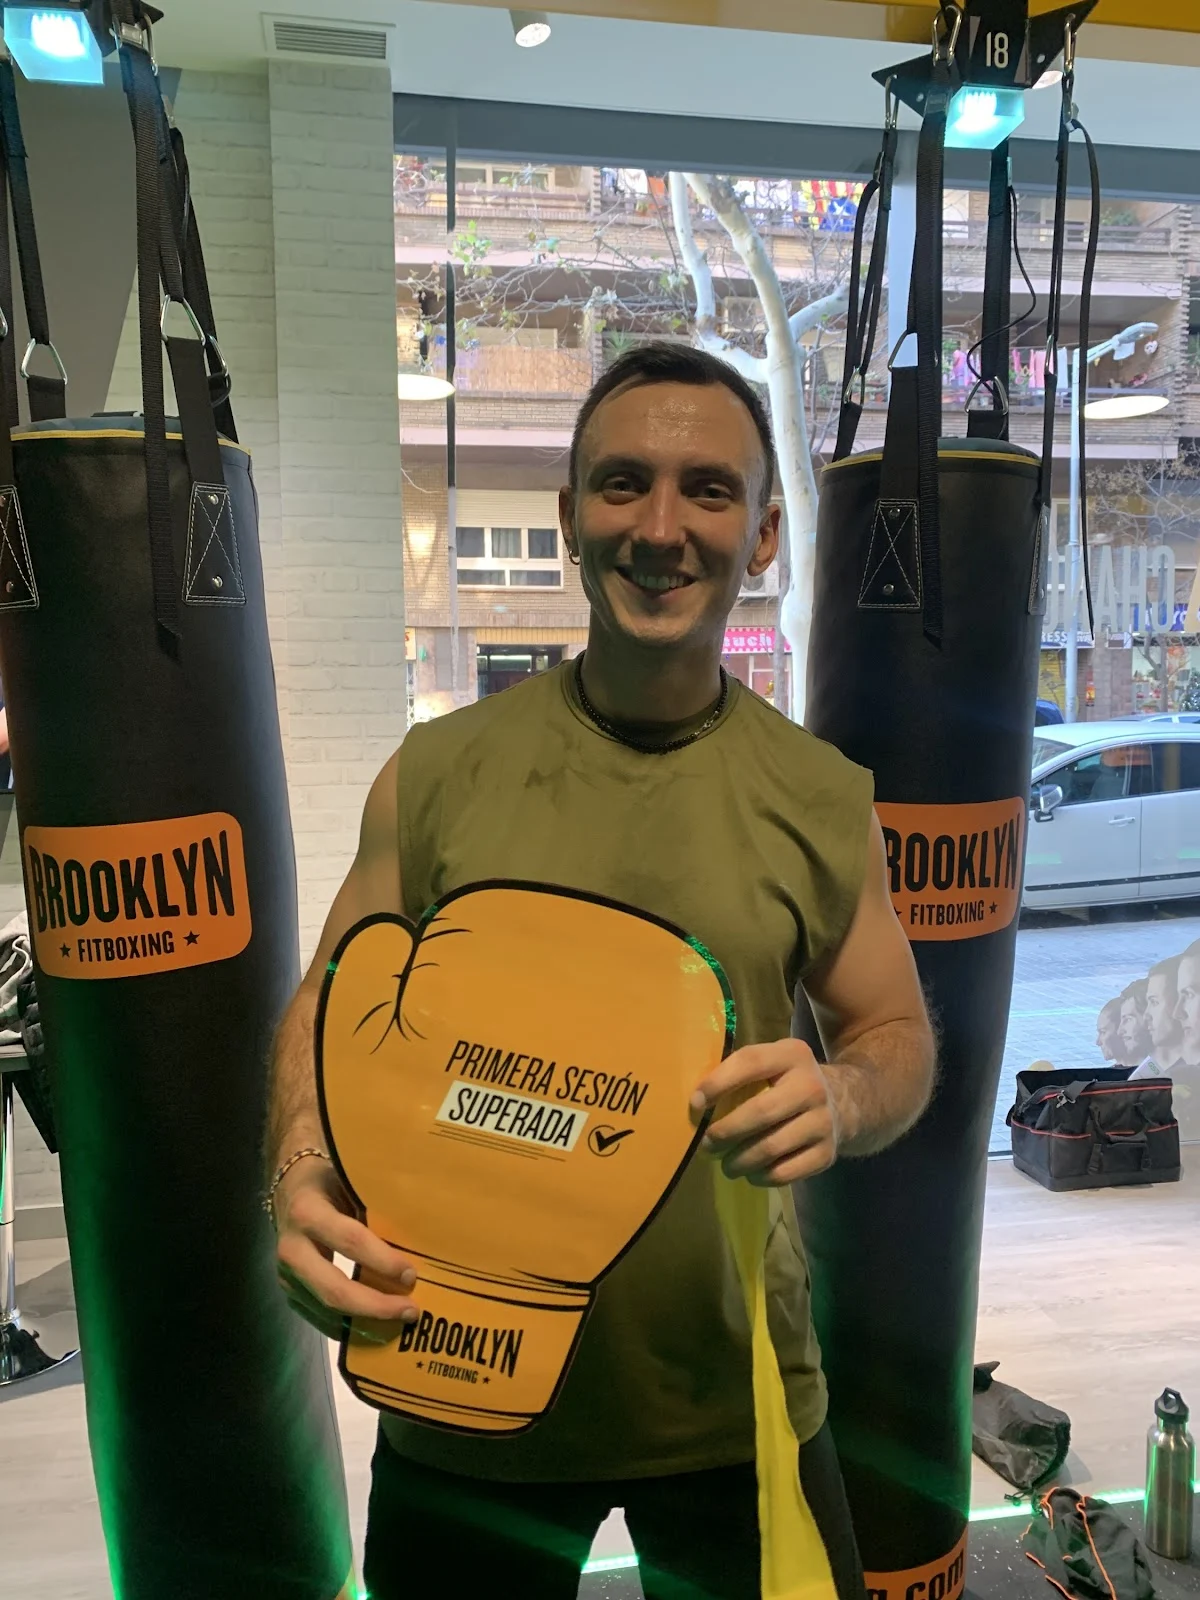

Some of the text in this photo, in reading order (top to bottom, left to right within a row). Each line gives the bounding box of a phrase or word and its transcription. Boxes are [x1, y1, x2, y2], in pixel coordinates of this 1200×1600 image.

[986, 31, 1009, 69] 18
[28, 829, 235, 933] BROOKLYN
[881, 812, 1020, 893] ROOKLYN
[910, 899, 985, 926] FITBOXING
[77, 930, 175, 963] FITBOXING
[444, 1039, 650, 1116] PRIMERA SESIÓN
[448, 1087, 577, 1147] SUPERADA
[397, 1309, 524, 1379] BROOKLYN
[427, 1360, 479, 1384] FITBOXING
